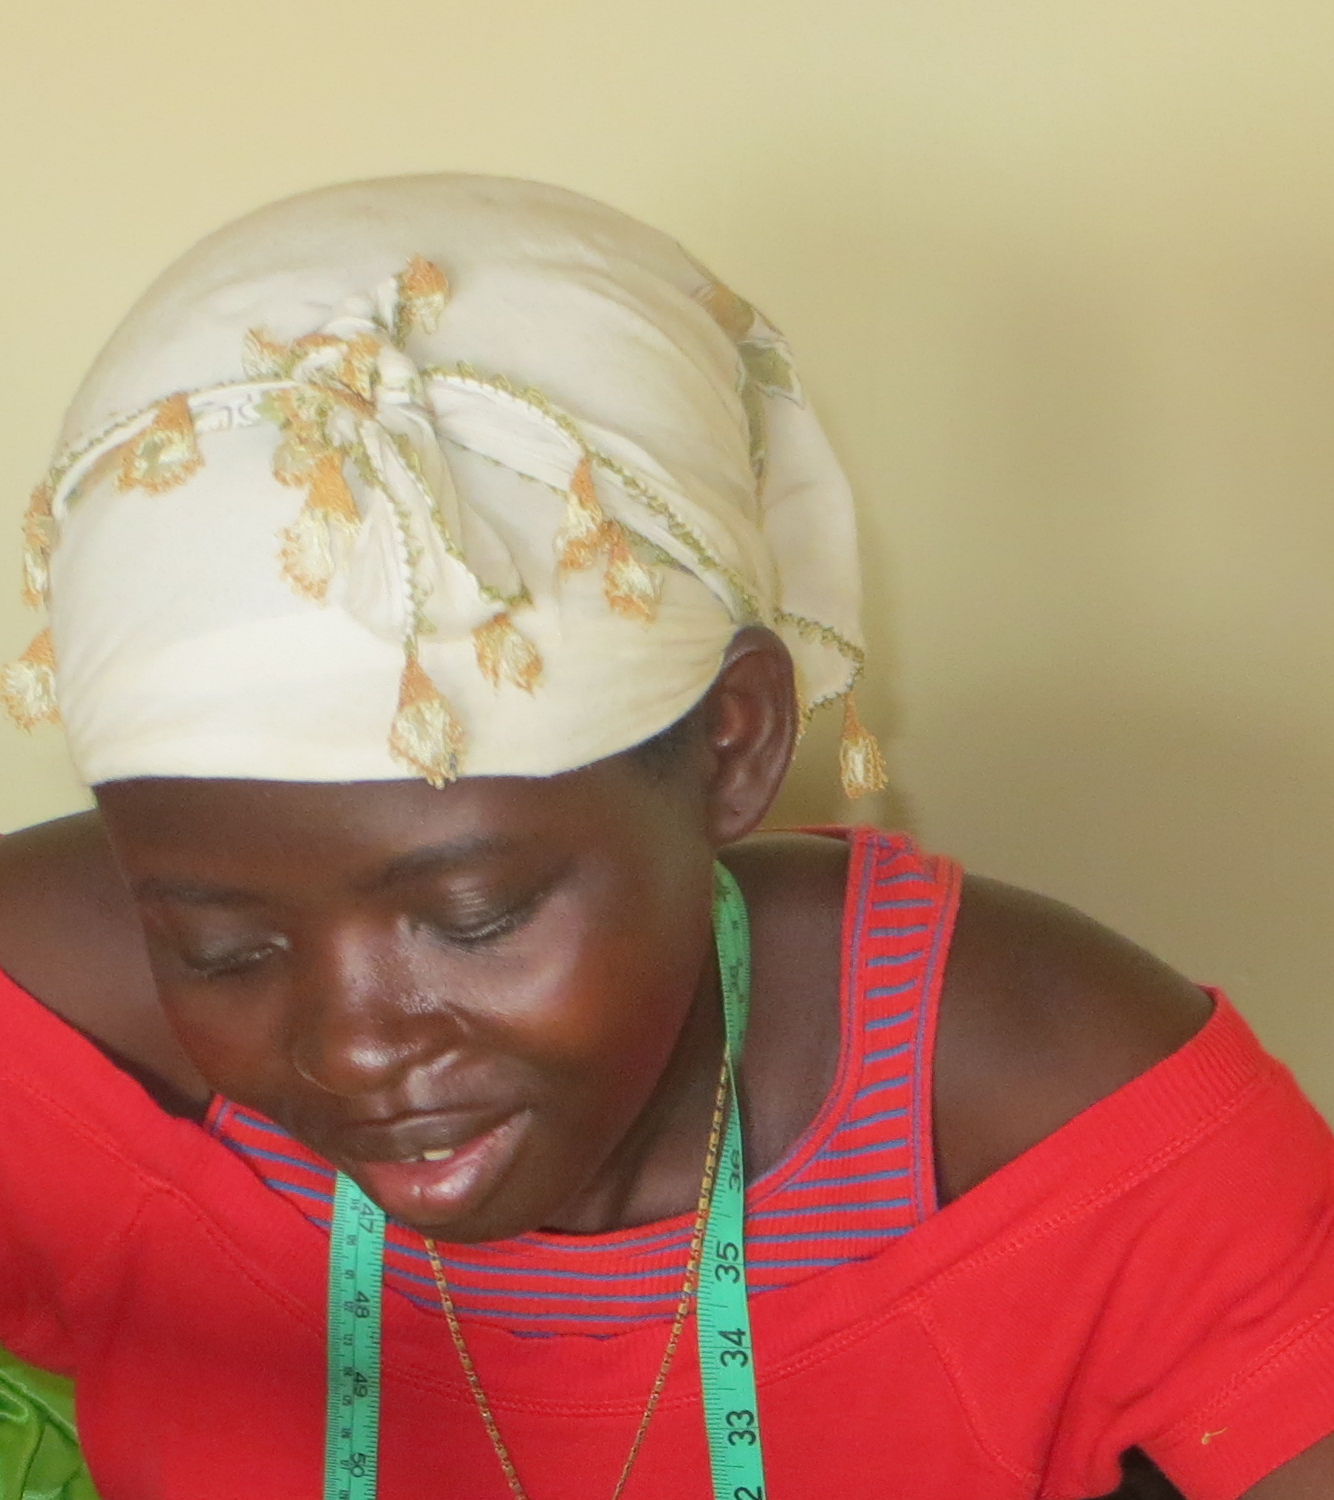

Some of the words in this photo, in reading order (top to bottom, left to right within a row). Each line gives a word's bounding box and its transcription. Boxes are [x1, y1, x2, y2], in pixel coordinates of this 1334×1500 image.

[728, 1150, 742, 1193] 36
[359, 1202, 375, 1234] 47
[714, 1241, 741, 1284] 35
[354, 1290, 371, 1320] 48
[720, 1327, 750, 1368] 34
[352, 1371, 369, 1398] 49
[725, 1409, 757, 1447] 33
[349, 1452, 366, 1478] 50
